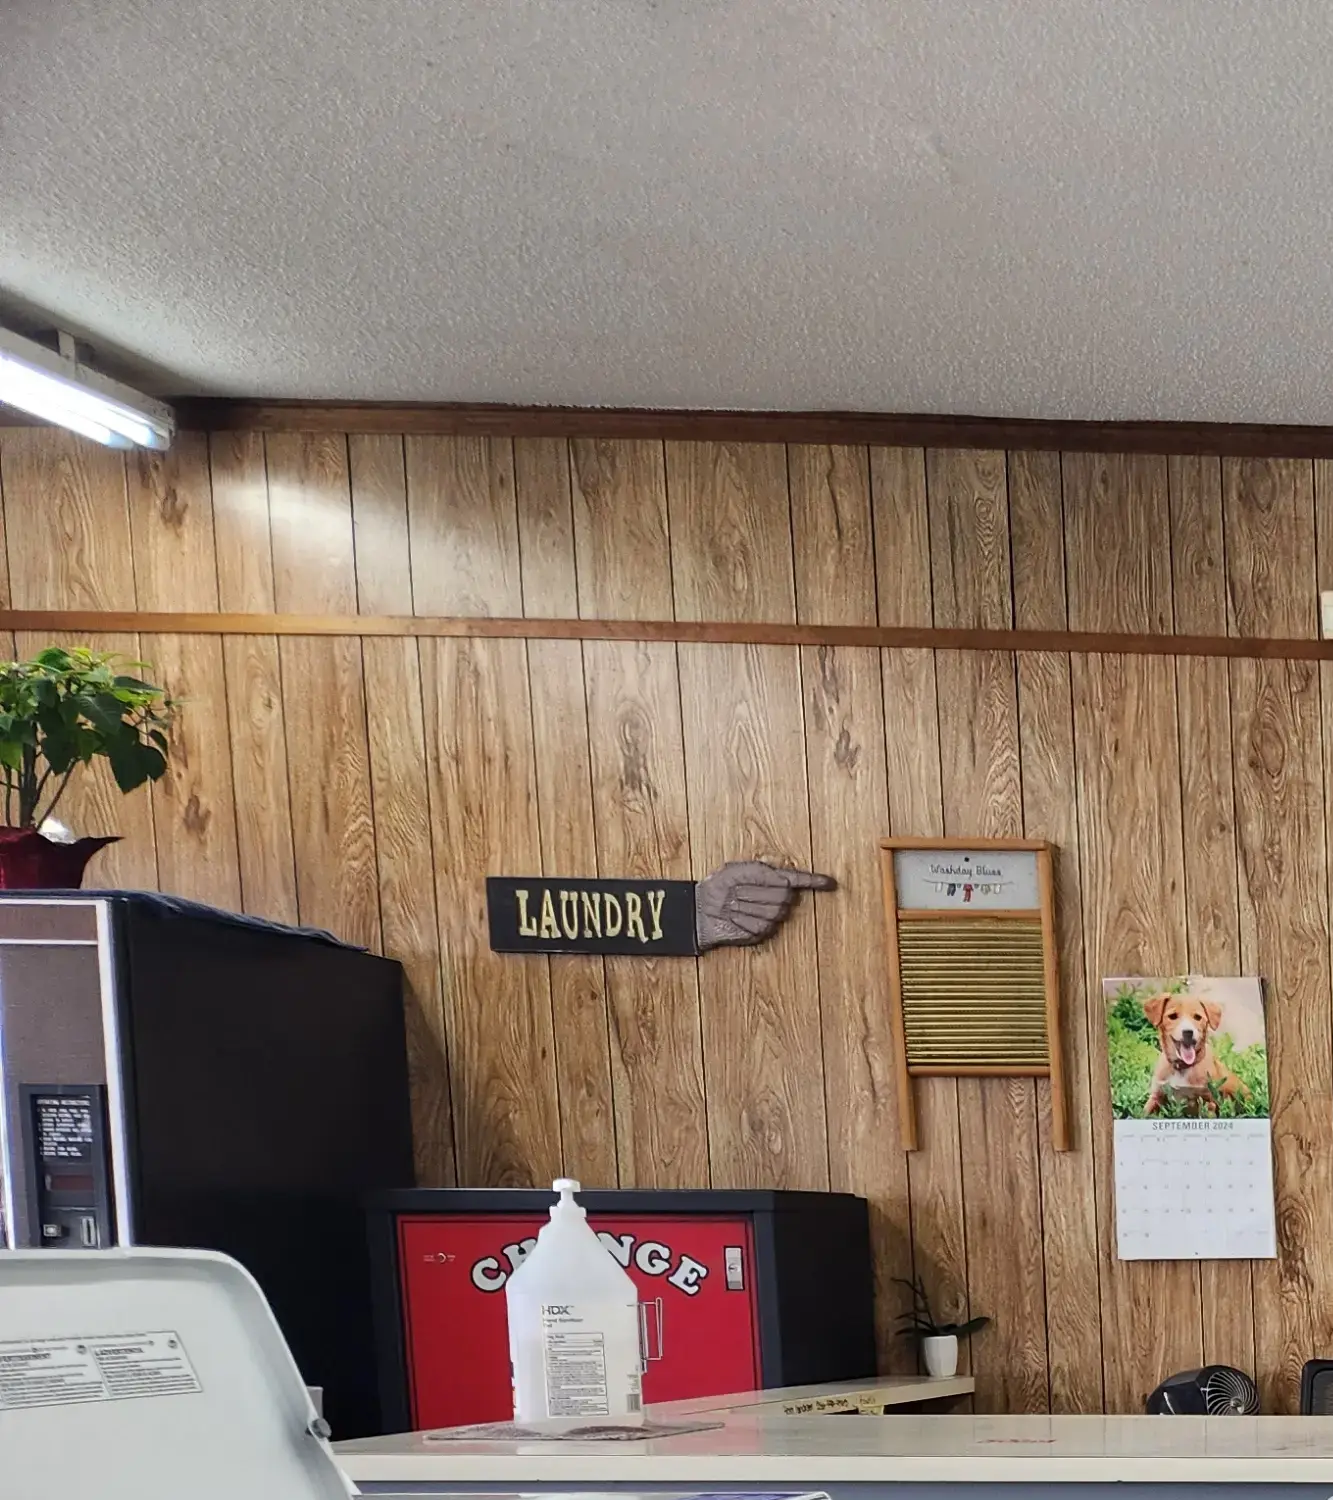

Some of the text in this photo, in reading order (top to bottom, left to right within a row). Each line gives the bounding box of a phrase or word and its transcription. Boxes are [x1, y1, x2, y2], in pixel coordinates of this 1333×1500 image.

[930, 864, 973, 880] Washday
[515, 889, 666, 944] LAUNDRY
[1152, 1121, 1234, 1130] SEPTEMBER 2024
[470, 1231, 710, 1297] CHNGE
[541, 1305, 571, 1316] HDX
